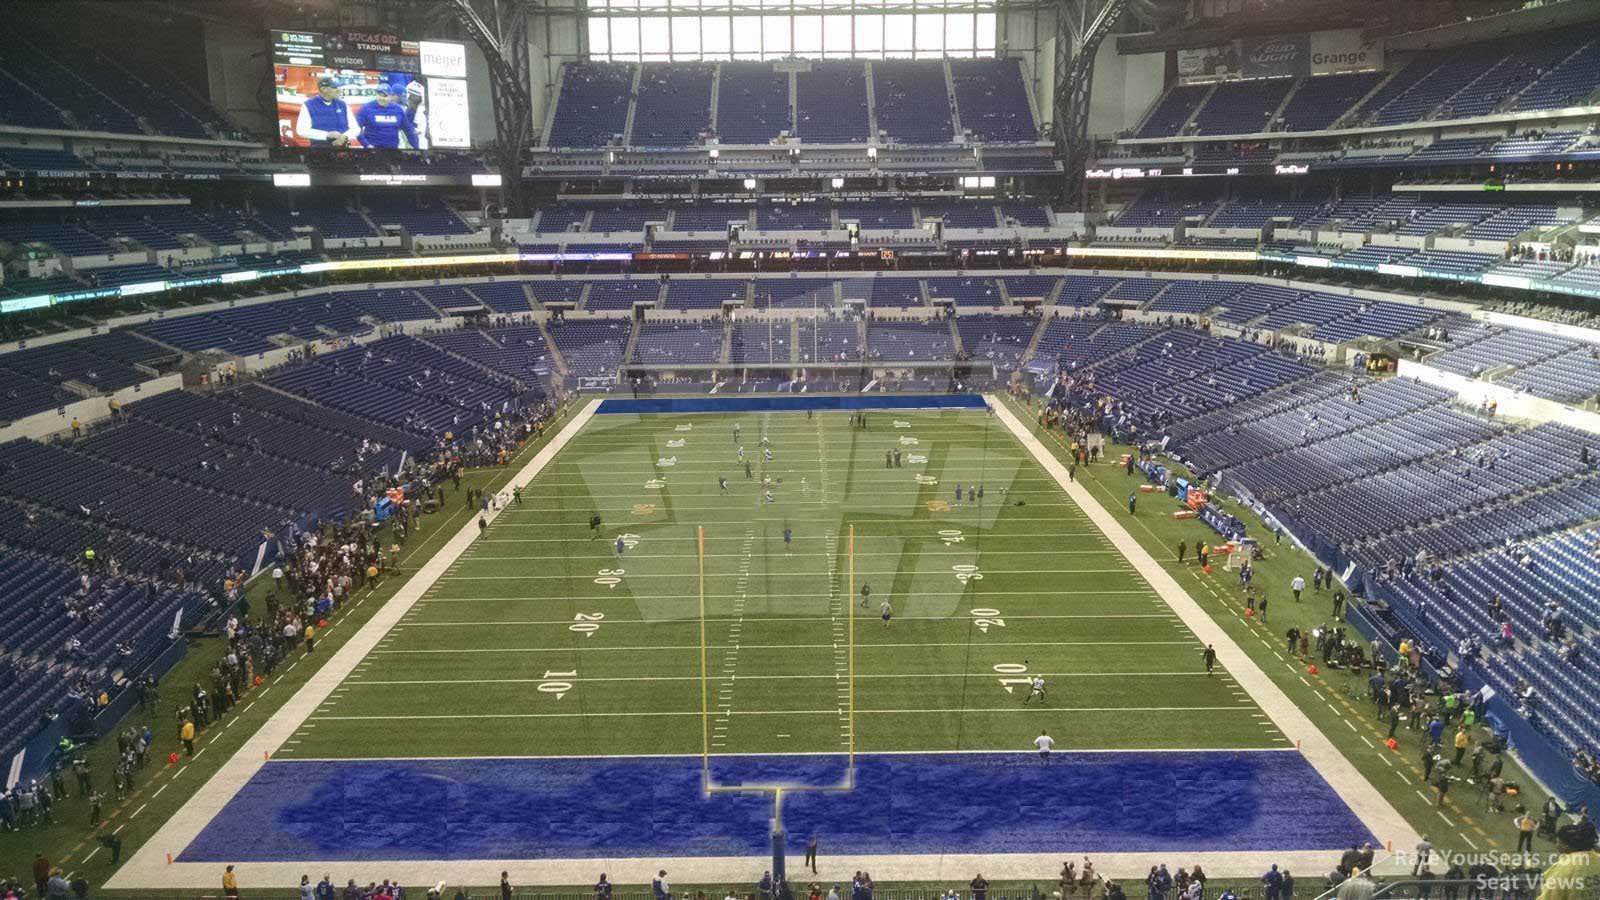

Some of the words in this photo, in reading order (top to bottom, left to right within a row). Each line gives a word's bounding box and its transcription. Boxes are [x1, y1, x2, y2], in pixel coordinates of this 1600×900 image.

[347, 32, 380, 43] LUCAS
[356, 43, 391, 52] STADIUM
[333, 56, 364, 65] verizon
[1312, 51, 1367, 65] Grange
[937, 529, 966, 543] 40
[593, 568, 625, 584] 30
[951, 564, 984, 580] 30
[568, 612, 605, 632] 20
[969, 608, 1006, 628] 20
[536, 669, 577, 692] 10
[993, 663, 1034, 686] 10
